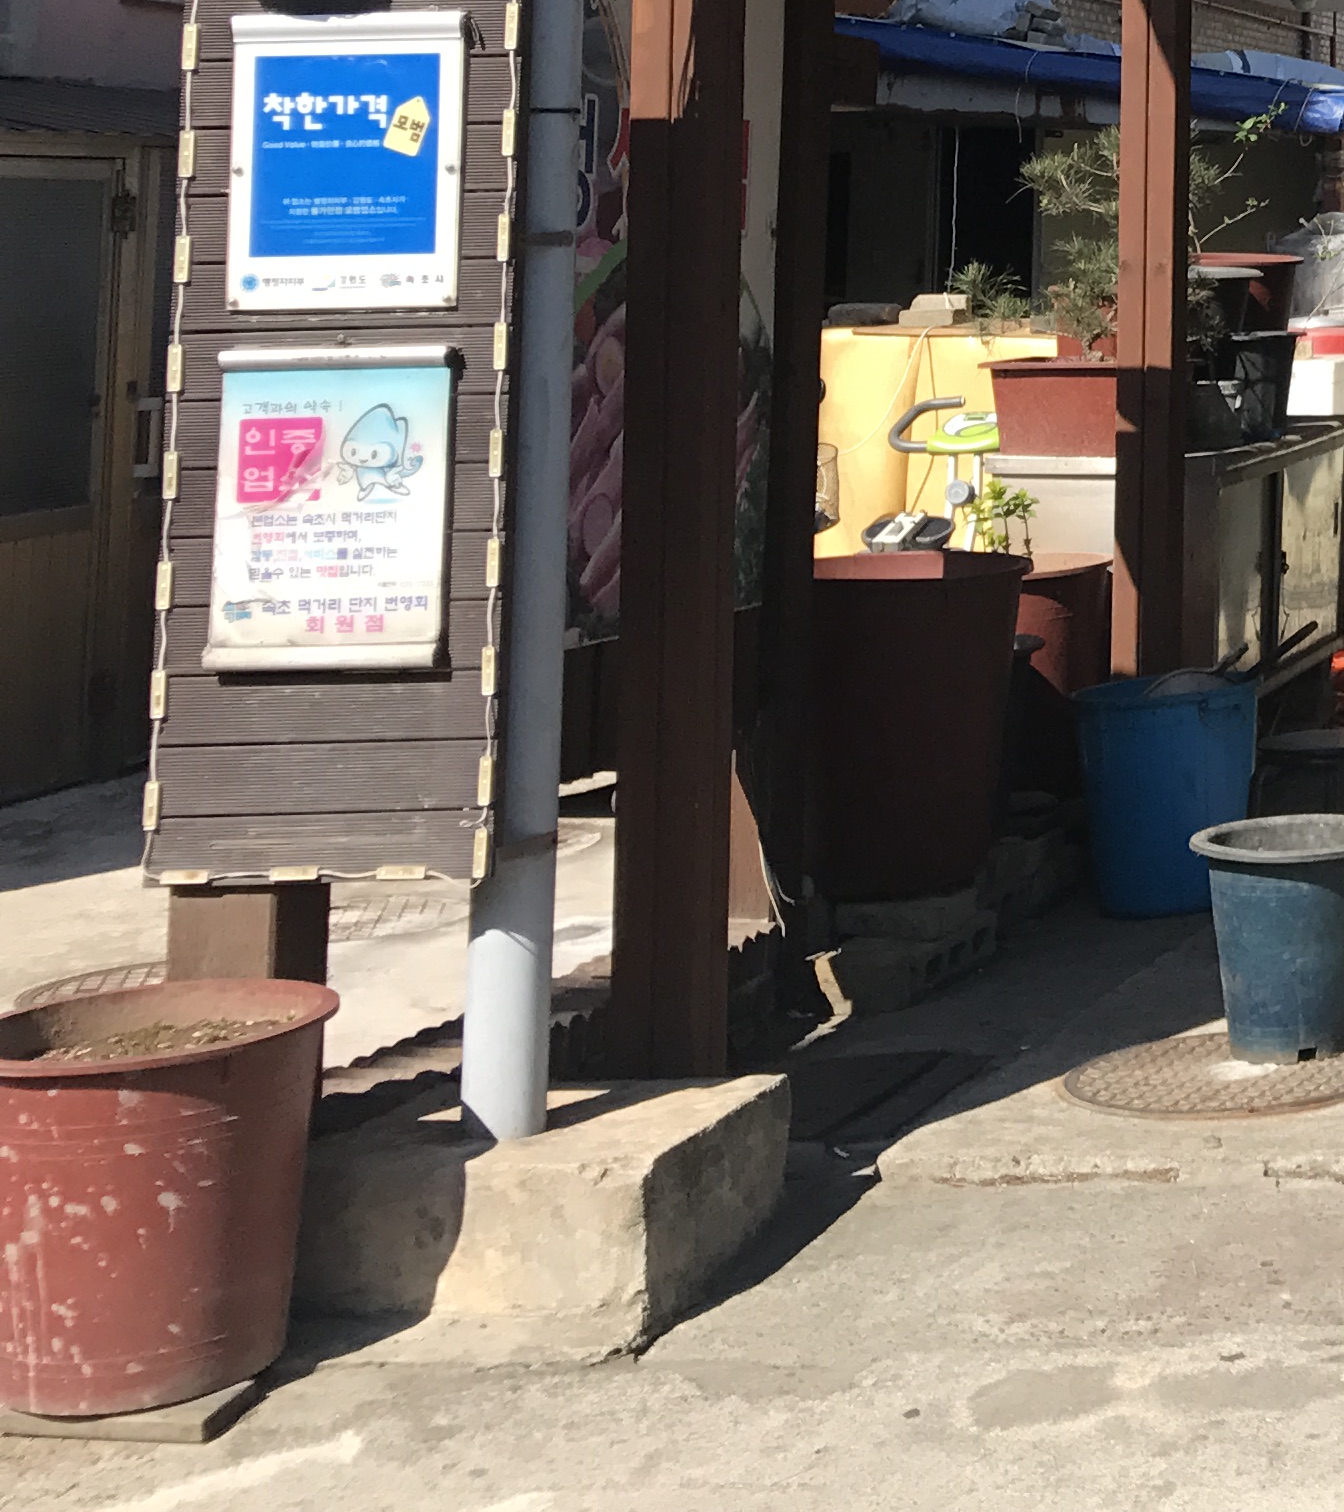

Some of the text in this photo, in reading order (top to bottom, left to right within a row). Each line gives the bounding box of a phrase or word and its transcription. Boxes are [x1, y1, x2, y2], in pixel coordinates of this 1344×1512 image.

[262, 92, 388, 131] 착한가격
[242, 400, 297, 415] 고객과의
[303, 399, 332, 414] 약속
[244, 427, 317, 456] 인증
[341, 510, 398, 525] 먹거리단지
[289, 566, 312, 579] 있는
[261, 595, 429, 616] 속초 먹거리 단지 번영회
